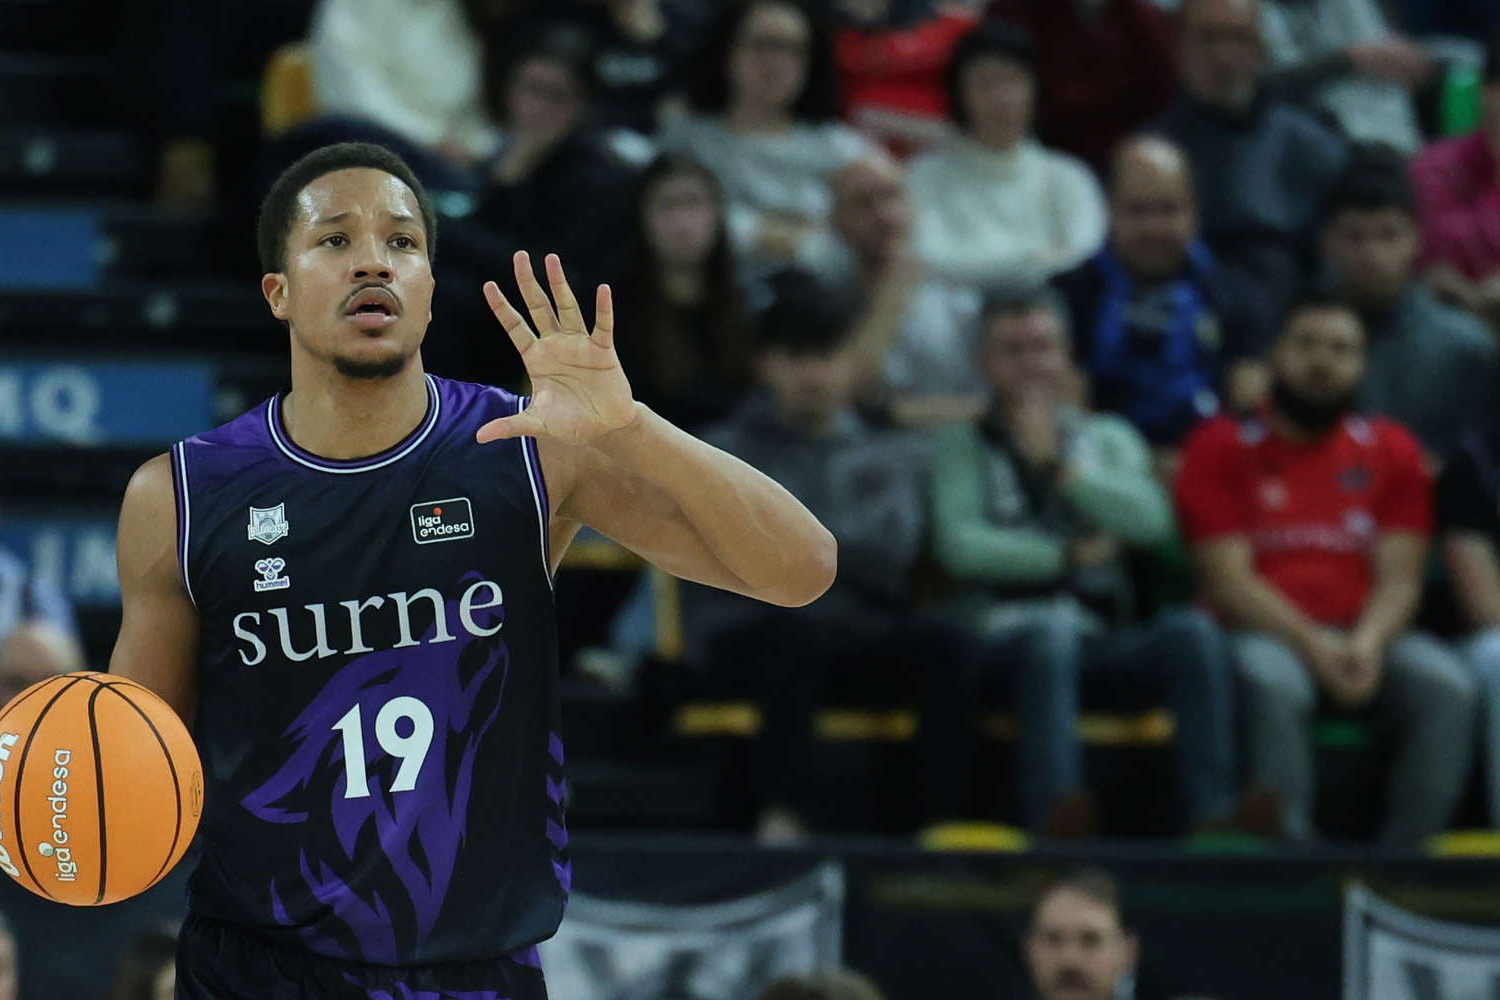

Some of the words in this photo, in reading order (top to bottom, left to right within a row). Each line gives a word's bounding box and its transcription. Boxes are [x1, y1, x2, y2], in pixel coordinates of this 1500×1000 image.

[418, 515, 441, 528] liga
[420, 522, 469, 538] endesa
[256, 578, 288, 590] hummel
[232, 580, 504, 666] surne
[331, 696, 435, 799] 19
[47, 749, 72, 845] endesa
[57, 847, 78, 882] liga
